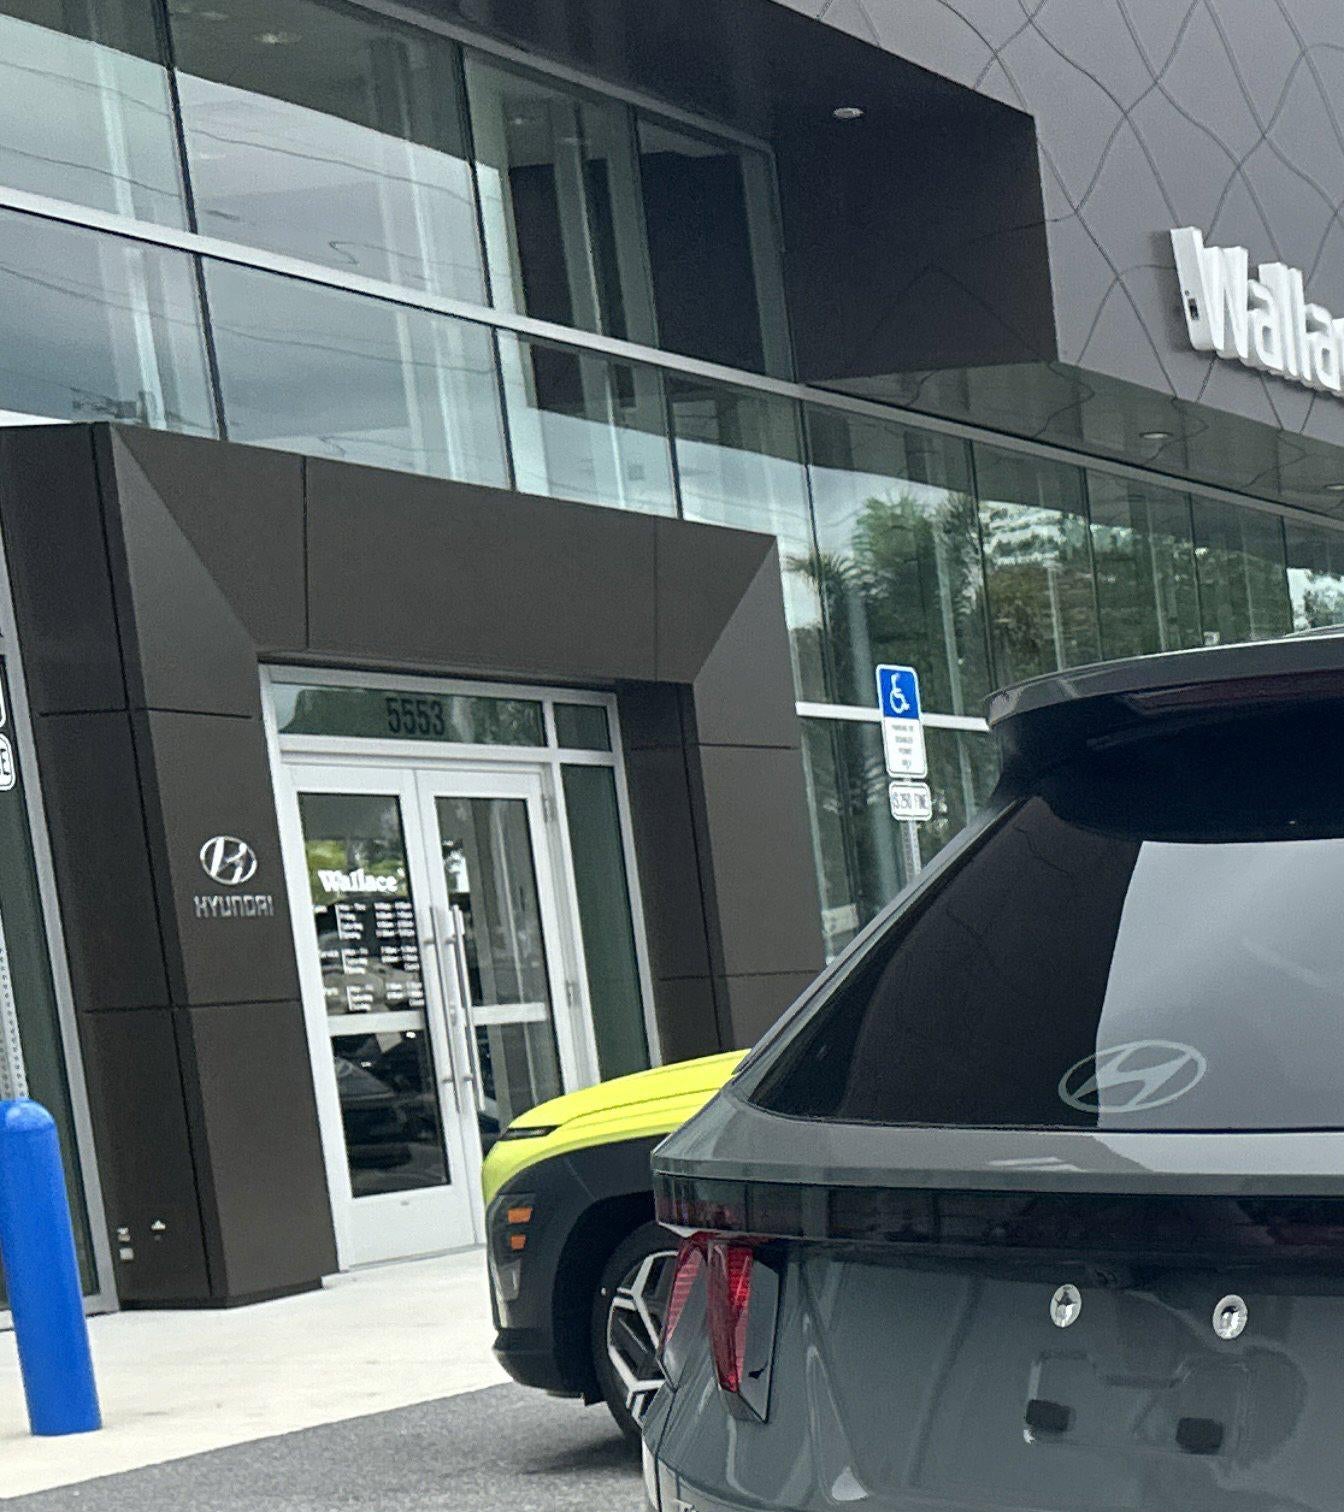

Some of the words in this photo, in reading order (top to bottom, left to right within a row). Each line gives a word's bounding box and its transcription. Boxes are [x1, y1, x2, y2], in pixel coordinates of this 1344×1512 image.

[385, 696, 445, 735] 5553
[318, 868, 398, 892] Wallace
[194, 895, 274, 918] HYUNDAI
